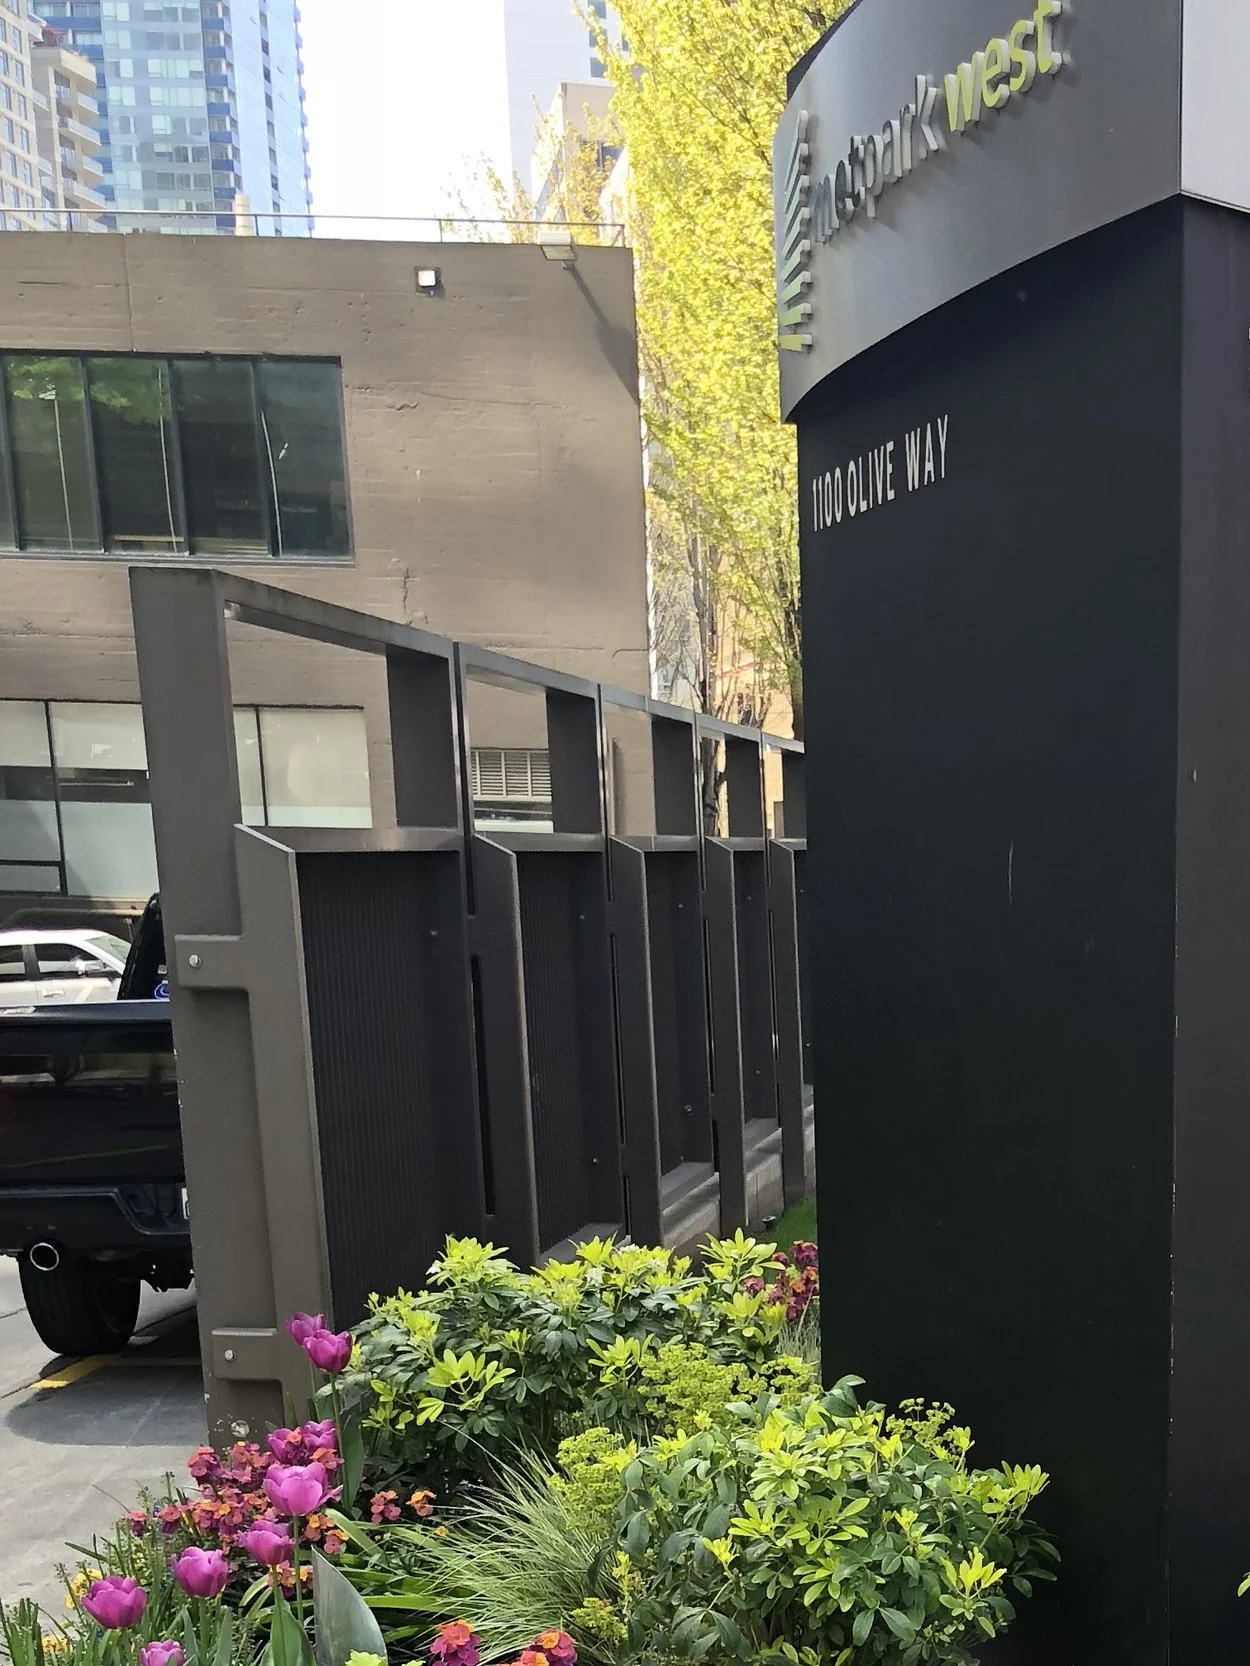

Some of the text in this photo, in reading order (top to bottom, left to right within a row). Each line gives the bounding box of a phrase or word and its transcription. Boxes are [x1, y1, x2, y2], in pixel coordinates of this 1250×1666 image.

[813, 0, 1062, 243] metpark west
[812, 414, 949, 532] 1100 OLIVE WAY
